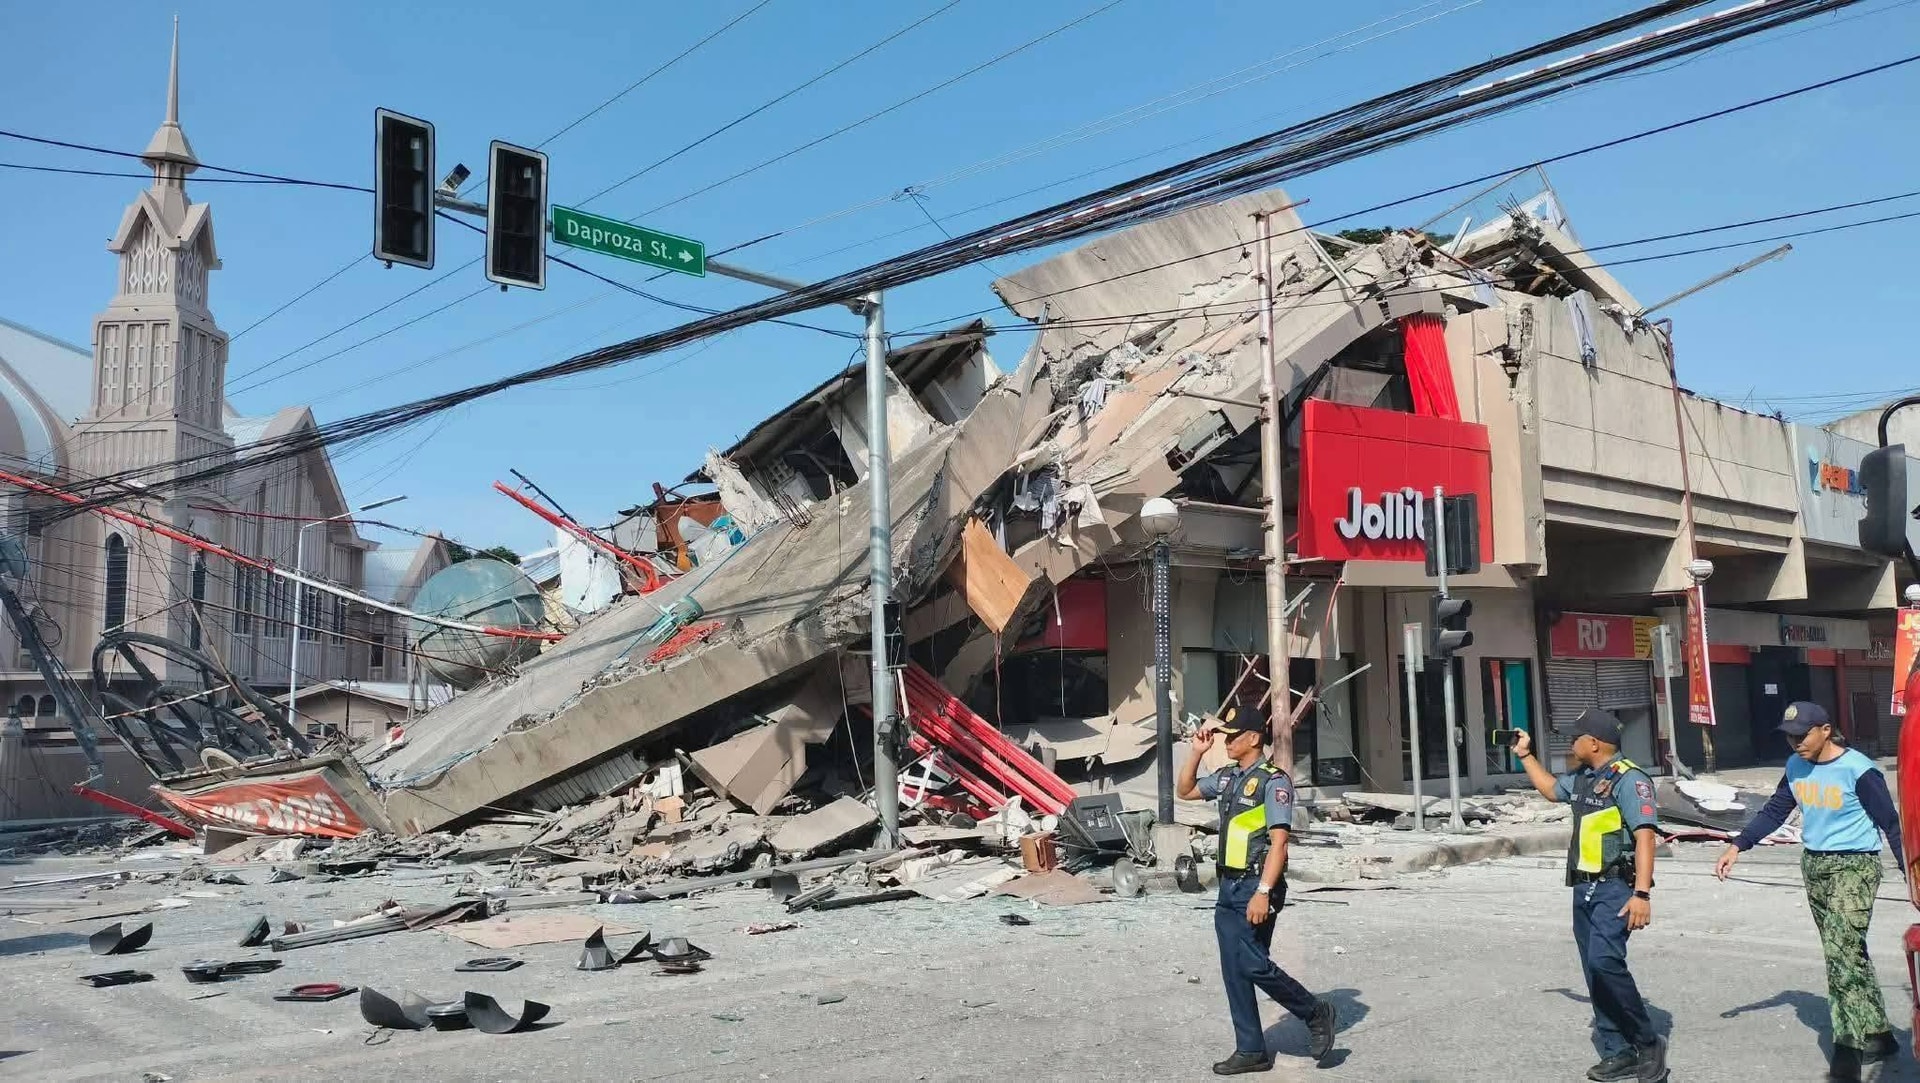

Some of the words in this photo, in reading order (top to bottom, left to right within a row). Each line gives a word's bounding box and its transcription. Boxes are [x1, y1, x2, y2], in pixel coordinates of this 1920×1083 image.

[567, 218, 642, 253] Daproza
[650, 240, 672, 260] St.
[1577, 618, 1607, 651] RD
